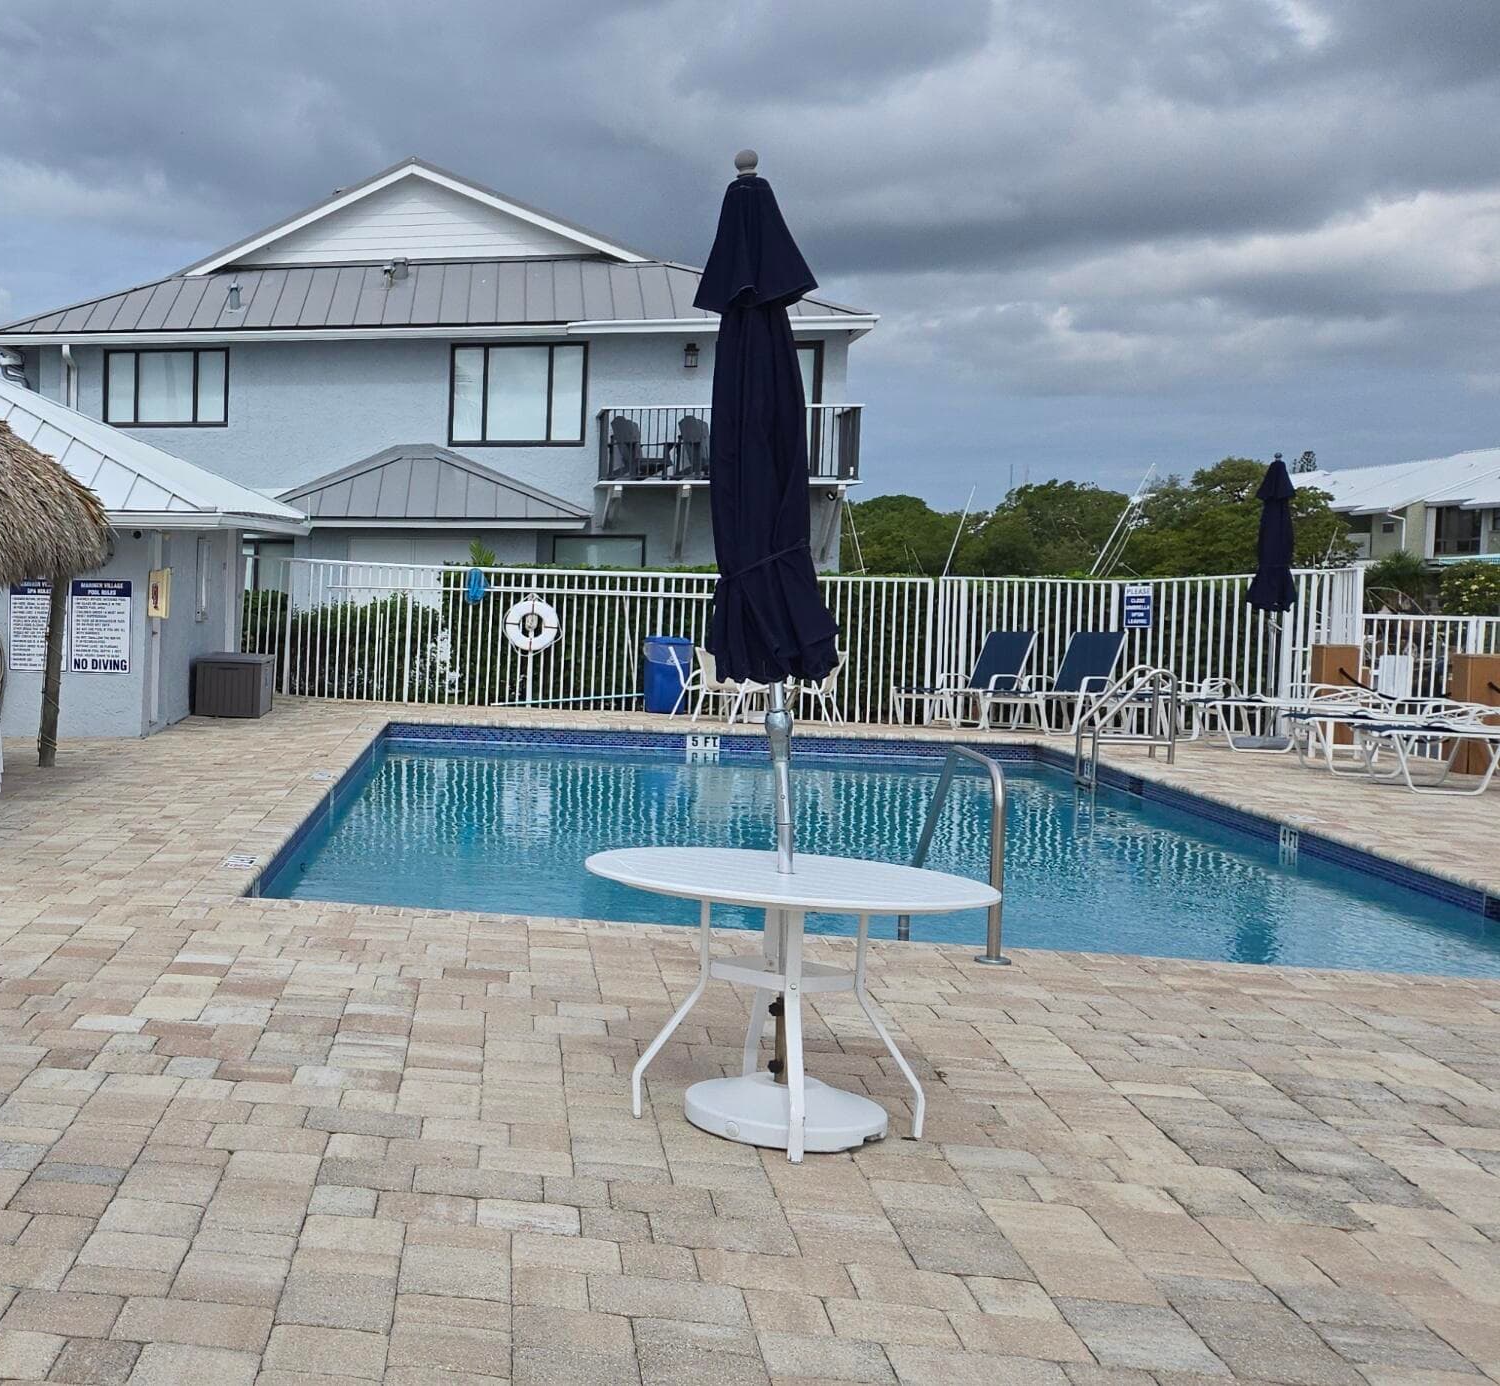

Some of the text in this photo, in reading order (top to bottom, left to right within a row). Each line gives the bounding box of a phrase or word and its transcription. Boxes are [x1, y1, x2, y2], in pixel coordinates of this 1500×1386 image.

[73, 658, 128, 671] NO DIVING
[692, 736, 718, 747] 5 FT
[1282, 828, 1297, 848] 4 FT
